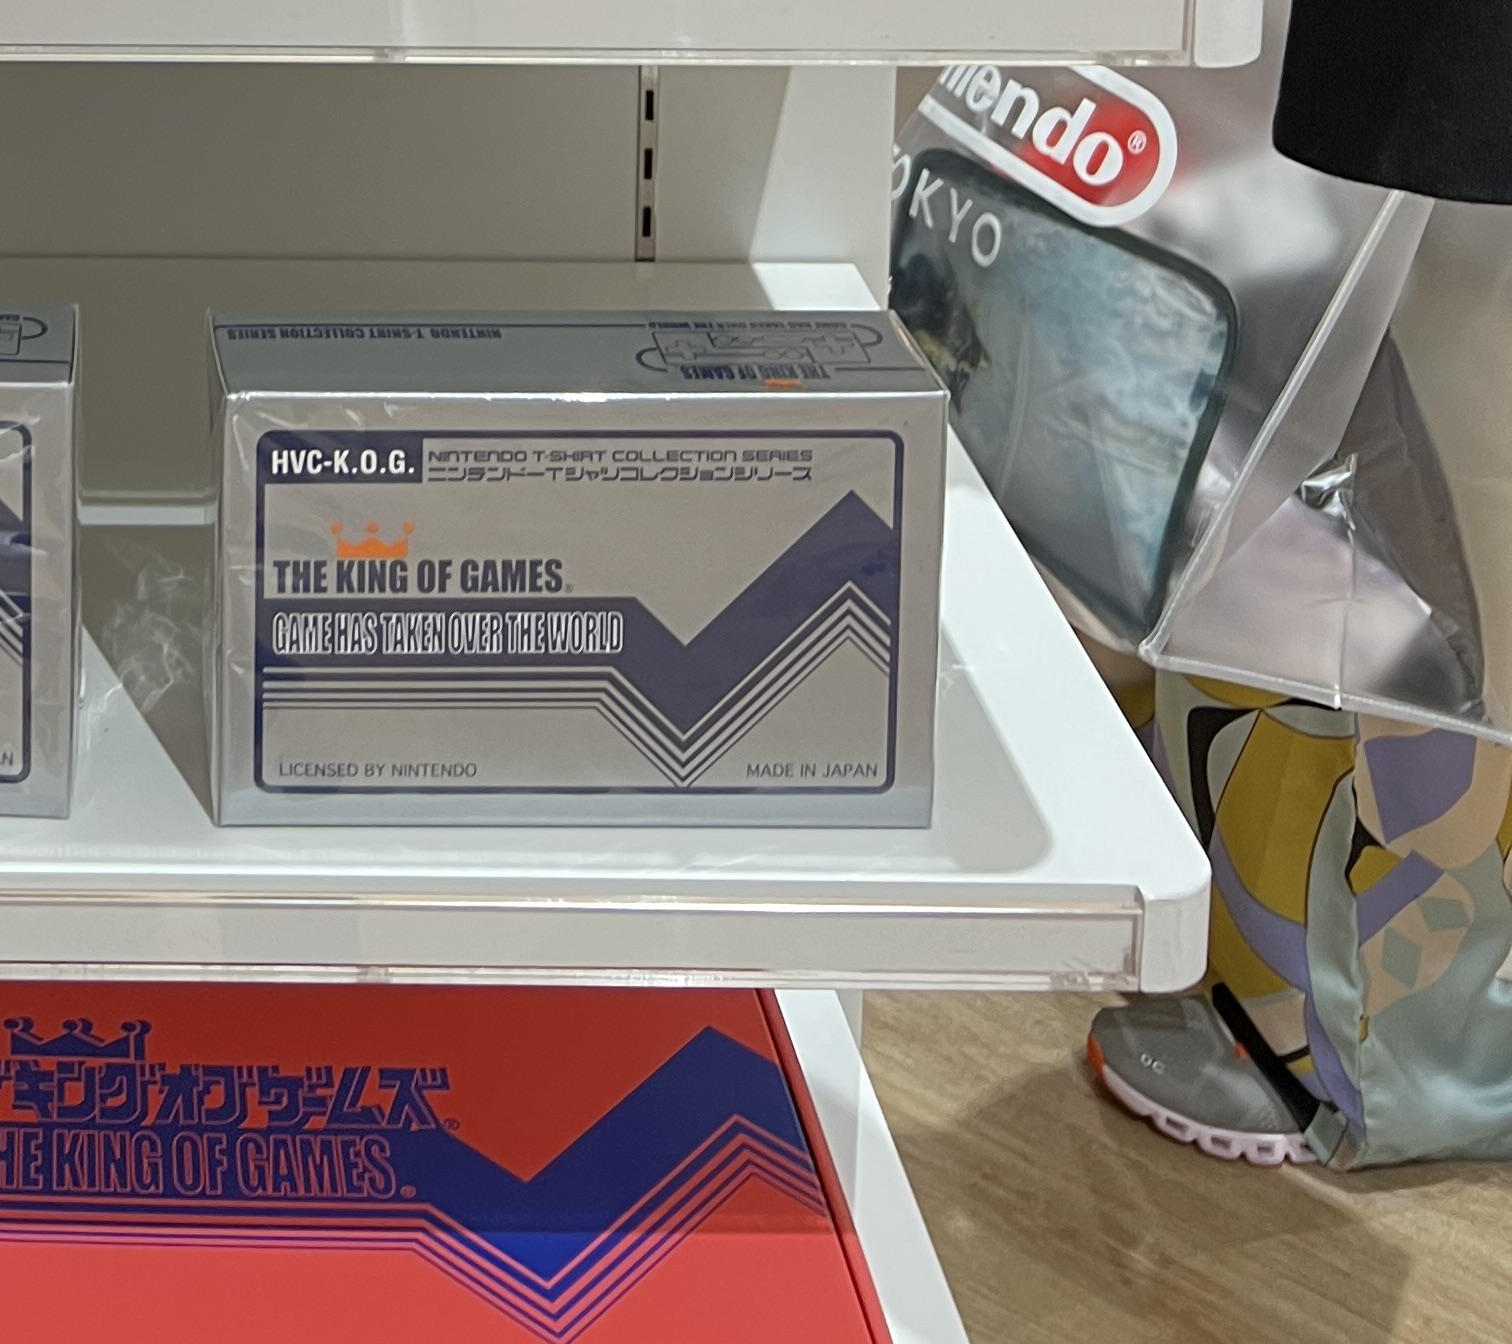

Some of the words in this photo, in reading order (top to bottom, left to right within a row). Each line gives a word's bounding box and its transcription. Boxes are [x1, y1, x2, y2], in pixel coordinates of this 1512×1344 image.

[891, 144, 1002, 267] OKYO
[272, 449, 415, 475] HVC-K.O.G.
[428, 450, 527, 462] NINTENDO
[532, 450, 607, 462] T-SHIRT
[612, 450, 737, 462] COLLECTION
[742, 450, 813, 462] SERIES
[273, 560, 328, 593] THE
[336, 560, 408, 593] KING
[417, 559, 453, 593] OF
[273, 612, 332, 655] GAME
[335, 612, 378, 654] HAS
[381, 612, 445, 654] TAKEN
[448, 612, 503, 654] OVER
[505, 612, 545, 654] THE
[546, 612, 624, 654] WORLD
[279, 763, 359, 777] LICENSED
[364, 763, 386, 777] BY
[391, 763, 477, 777] NINTENDO
[746, 763, 793, 777] MADE
[800, 763, 816, 777] IN
[823, 763, 878, 777] JAPAN
[52, 1127, 165, 1194] KING
[173, 1130, 238, 1195] OF
